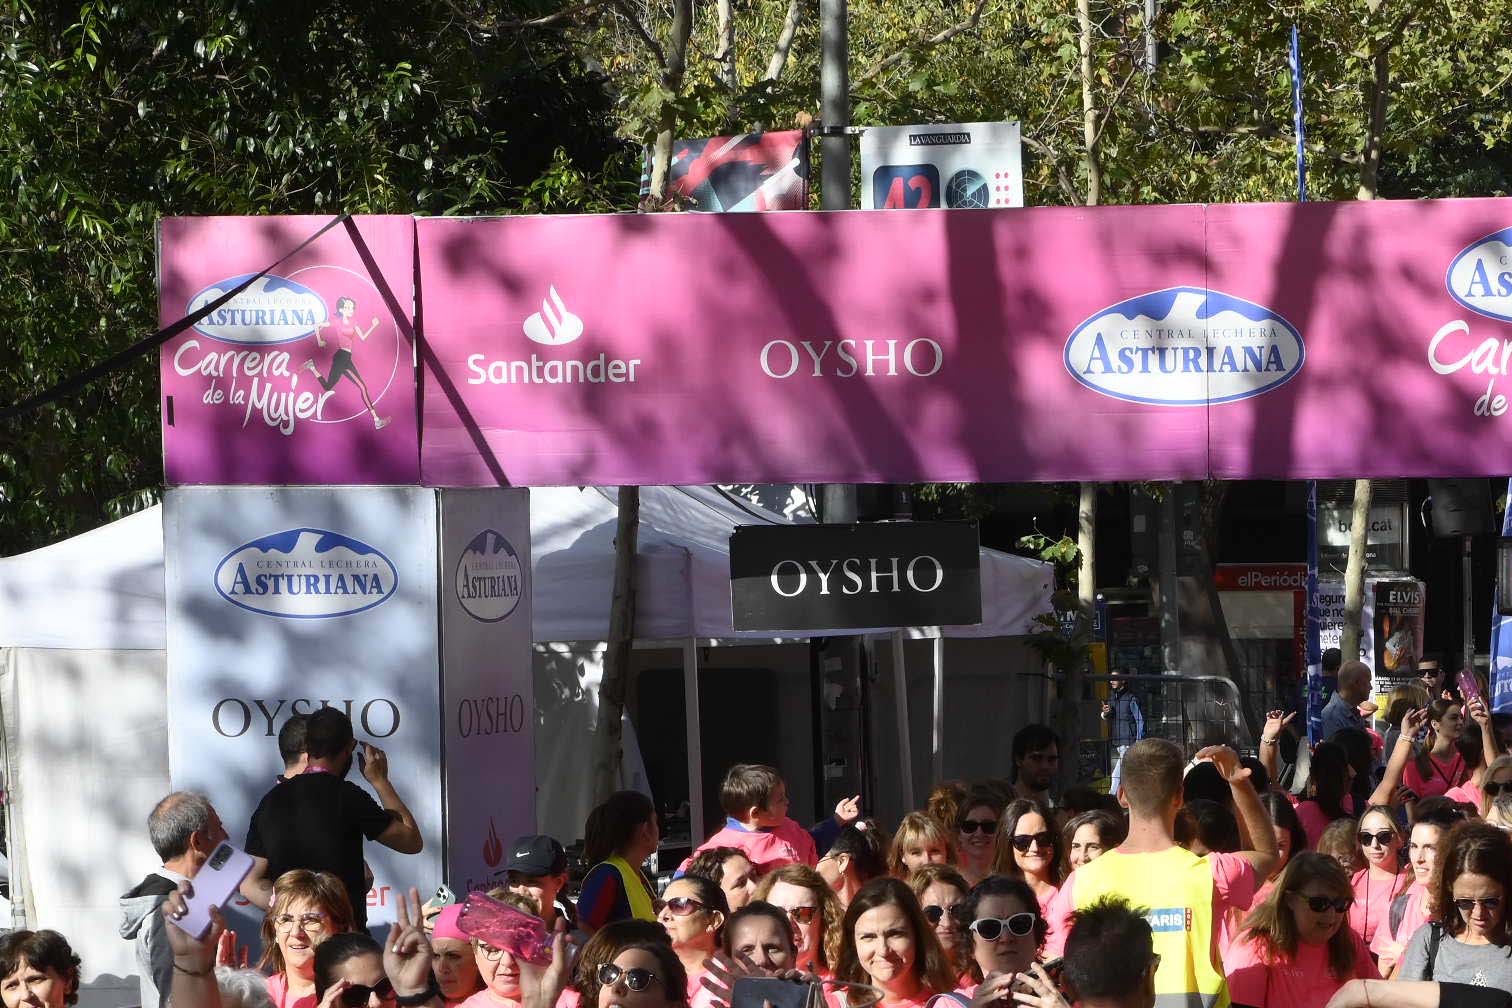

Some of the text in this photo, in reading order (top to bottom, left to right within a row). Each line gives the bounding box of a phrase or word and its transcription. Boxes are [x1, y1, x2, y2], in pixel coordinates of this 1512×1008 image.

[1121, 327, 1278, 340] CENTRAL LECHERA
[174, 340, 290, 376] Carrera
[467, 354, 640, 385] Santander
[760, 338, 943, 379] OYSHO
[1083, 334, 1286, 375] ASTURIANA
[203, 374, 335, 435] de la Mujer
[1474, 377, 1508, 417] de
[229, 562, 384, 596] ASTURIANA
[257, 559, 378, 569] CENTRAL LECHERA
[461, 564, 519, 600] ASTURIANA
[770, 555, 944, 597] OYSHO
[1238, 570, 1306, 589] elPeriódi
[1389, 591, 1420, 603] ELVIS
[458, 693, 524, 738] OYSHO
